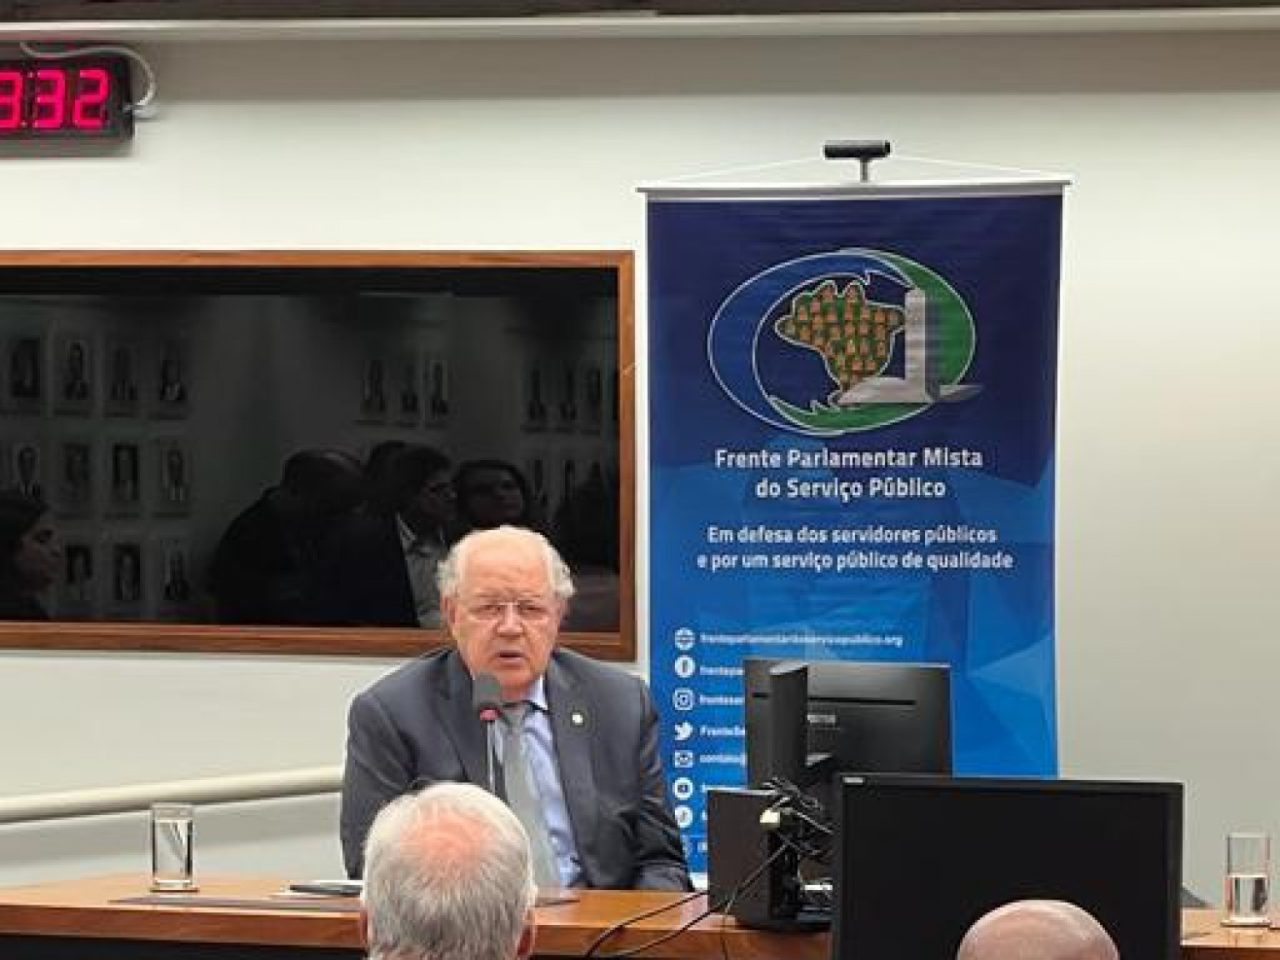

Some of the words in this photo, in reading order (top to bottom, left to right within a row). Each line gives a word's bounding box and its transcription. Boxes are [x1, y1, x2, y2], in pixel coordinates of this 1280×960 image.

[715, 449, 781, 468] Frente
[787, 448, 917, 468] Parlamentar
[923, 448, 984, 467] Mista
[756, 478, 781, 497] do
[787, 477, 863, 502] Serviço
[869, 476, 946, 497] Público
[707, 526, 733, 543] Em
[737, 525, 793, 543] defesa
[797, 525, 828, 543] dos
[832, 525, 920, 543] servidores
[924, 525, 998, 546] públicos
[697, 555, 707, 568] e
[711, 555, 738, 572] por
[742, 555, 768, 568] um
[771, 553, 833, 572] serviço
[837, 552, 898, 572] público
[902, 553, 924, 568] de
[926, 553, 1014, 572] qualidade
